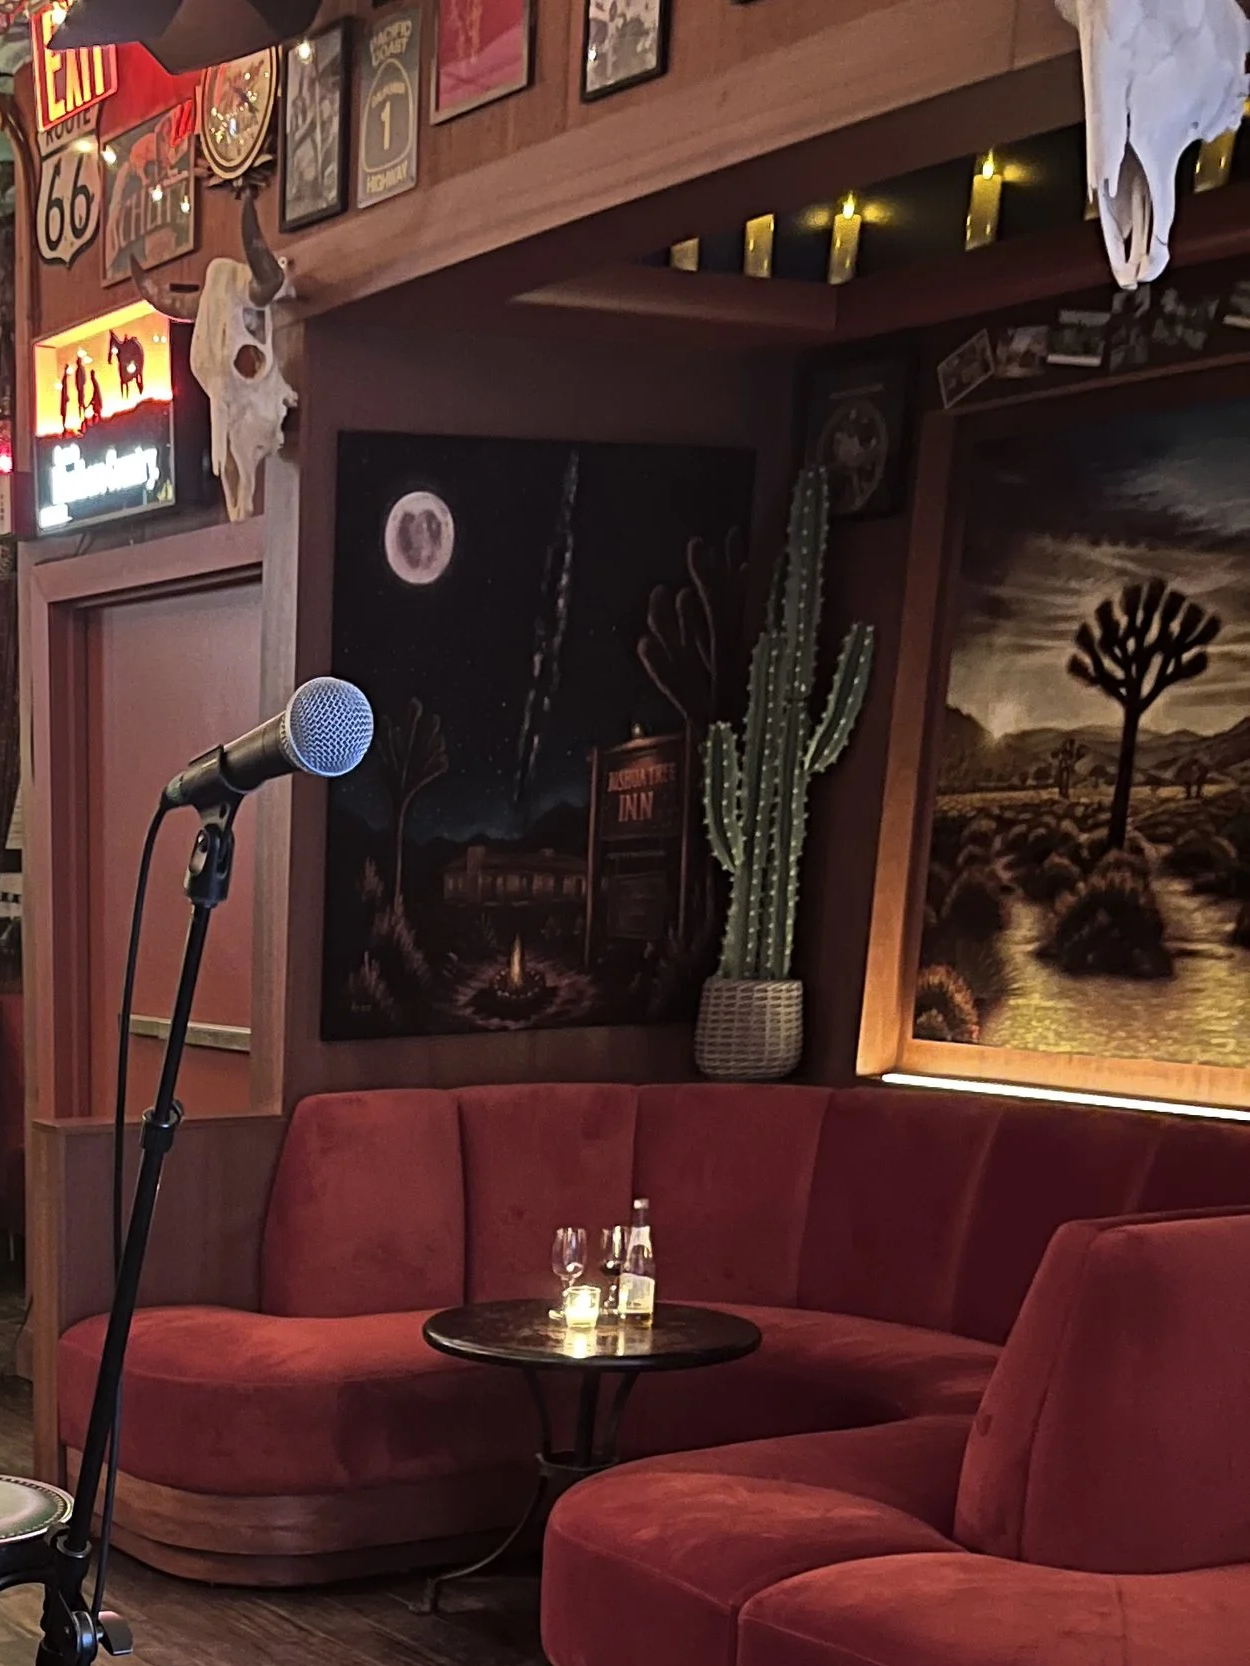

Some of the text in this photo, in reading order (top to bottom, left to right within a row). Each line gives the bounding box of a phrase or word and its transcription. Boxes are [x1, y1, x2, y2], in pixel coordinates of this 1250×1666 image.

[380, 100, 391, 150] 1
[366, 160, 408, 194] HIGHWAY
[44, 155, 91, 251] 66
[618, 791, 654, 822] INN
